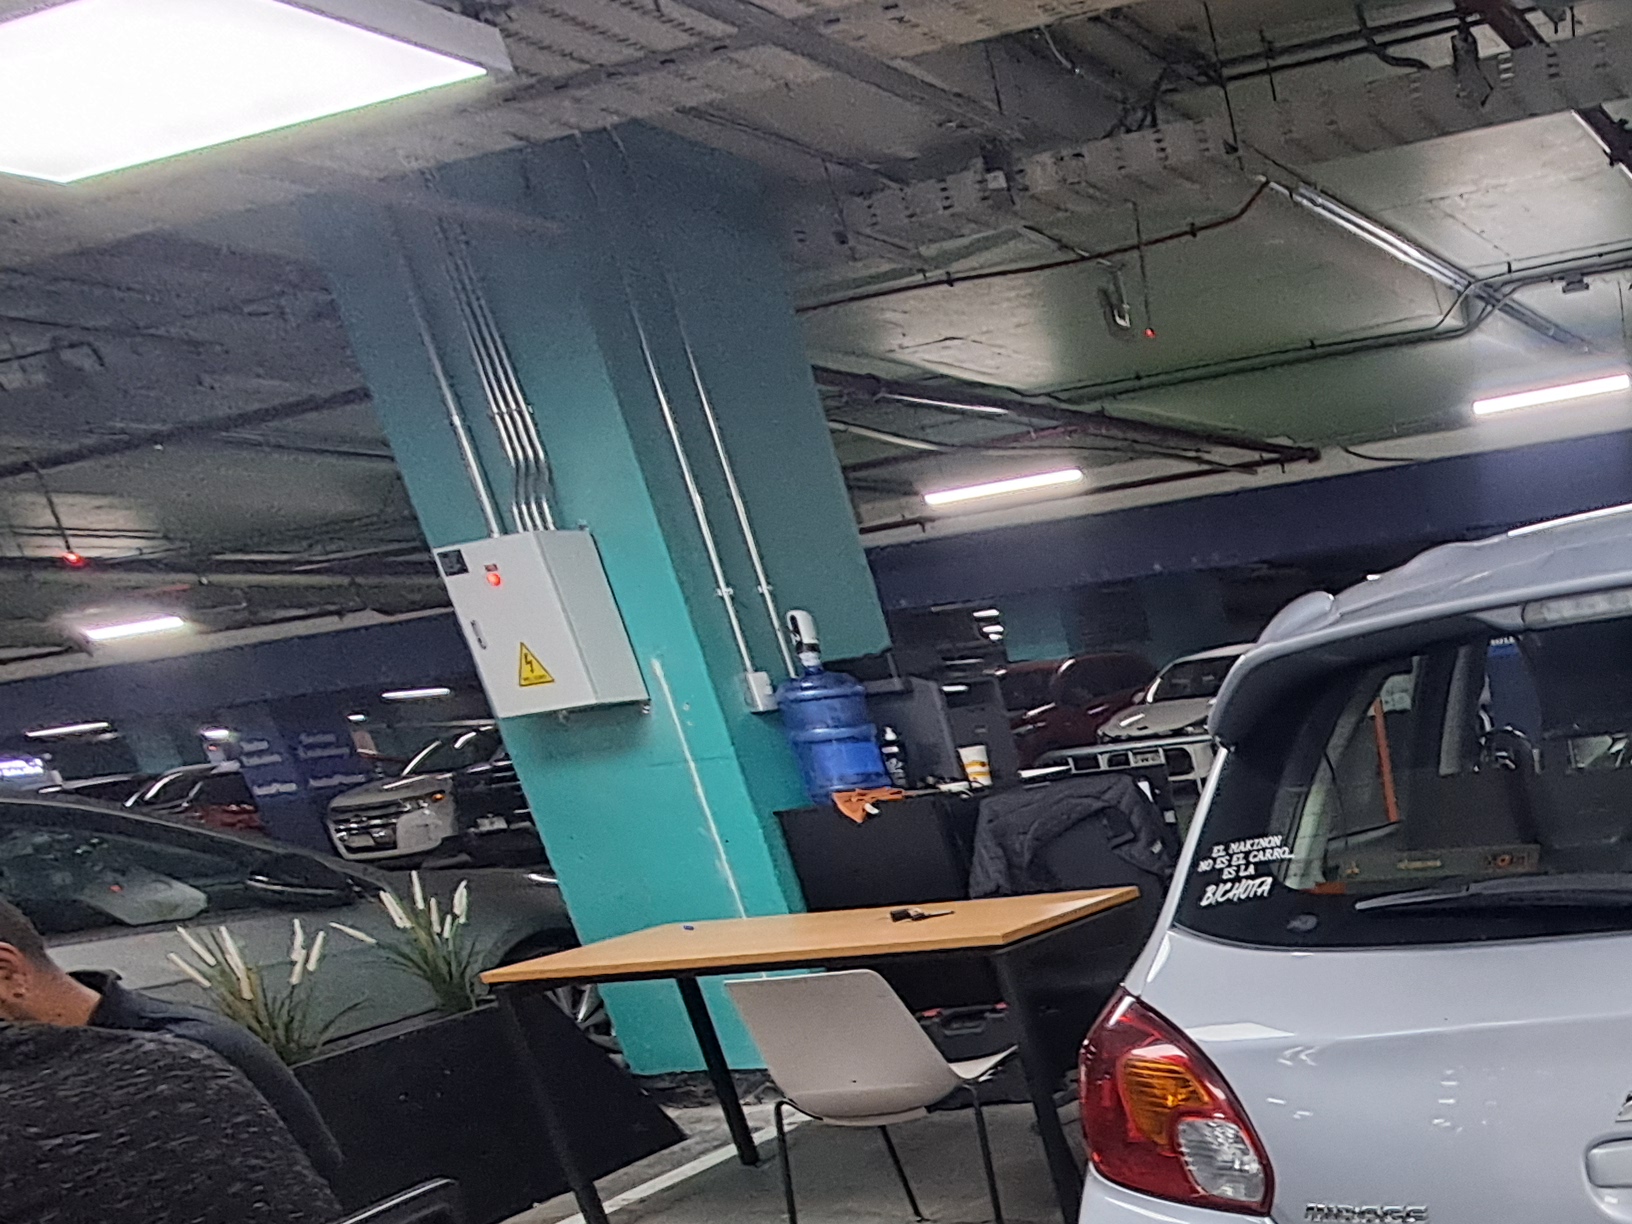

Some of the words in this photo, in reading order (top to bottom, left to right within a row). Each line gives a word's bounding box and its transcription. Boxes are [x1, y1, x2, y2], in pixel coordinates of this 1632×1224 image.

[1211, 844, 1227, 858] EL
[1197, 858, 1214, 872] NO
[1214, 855, 1230, 869] ES
[1231, 853, 1247, 866] EL
[1221, 866, 1238, 880] ES
[1238, 863, 1256, 877] LA
[1199, 876, 1274, 907] BICHOTA
